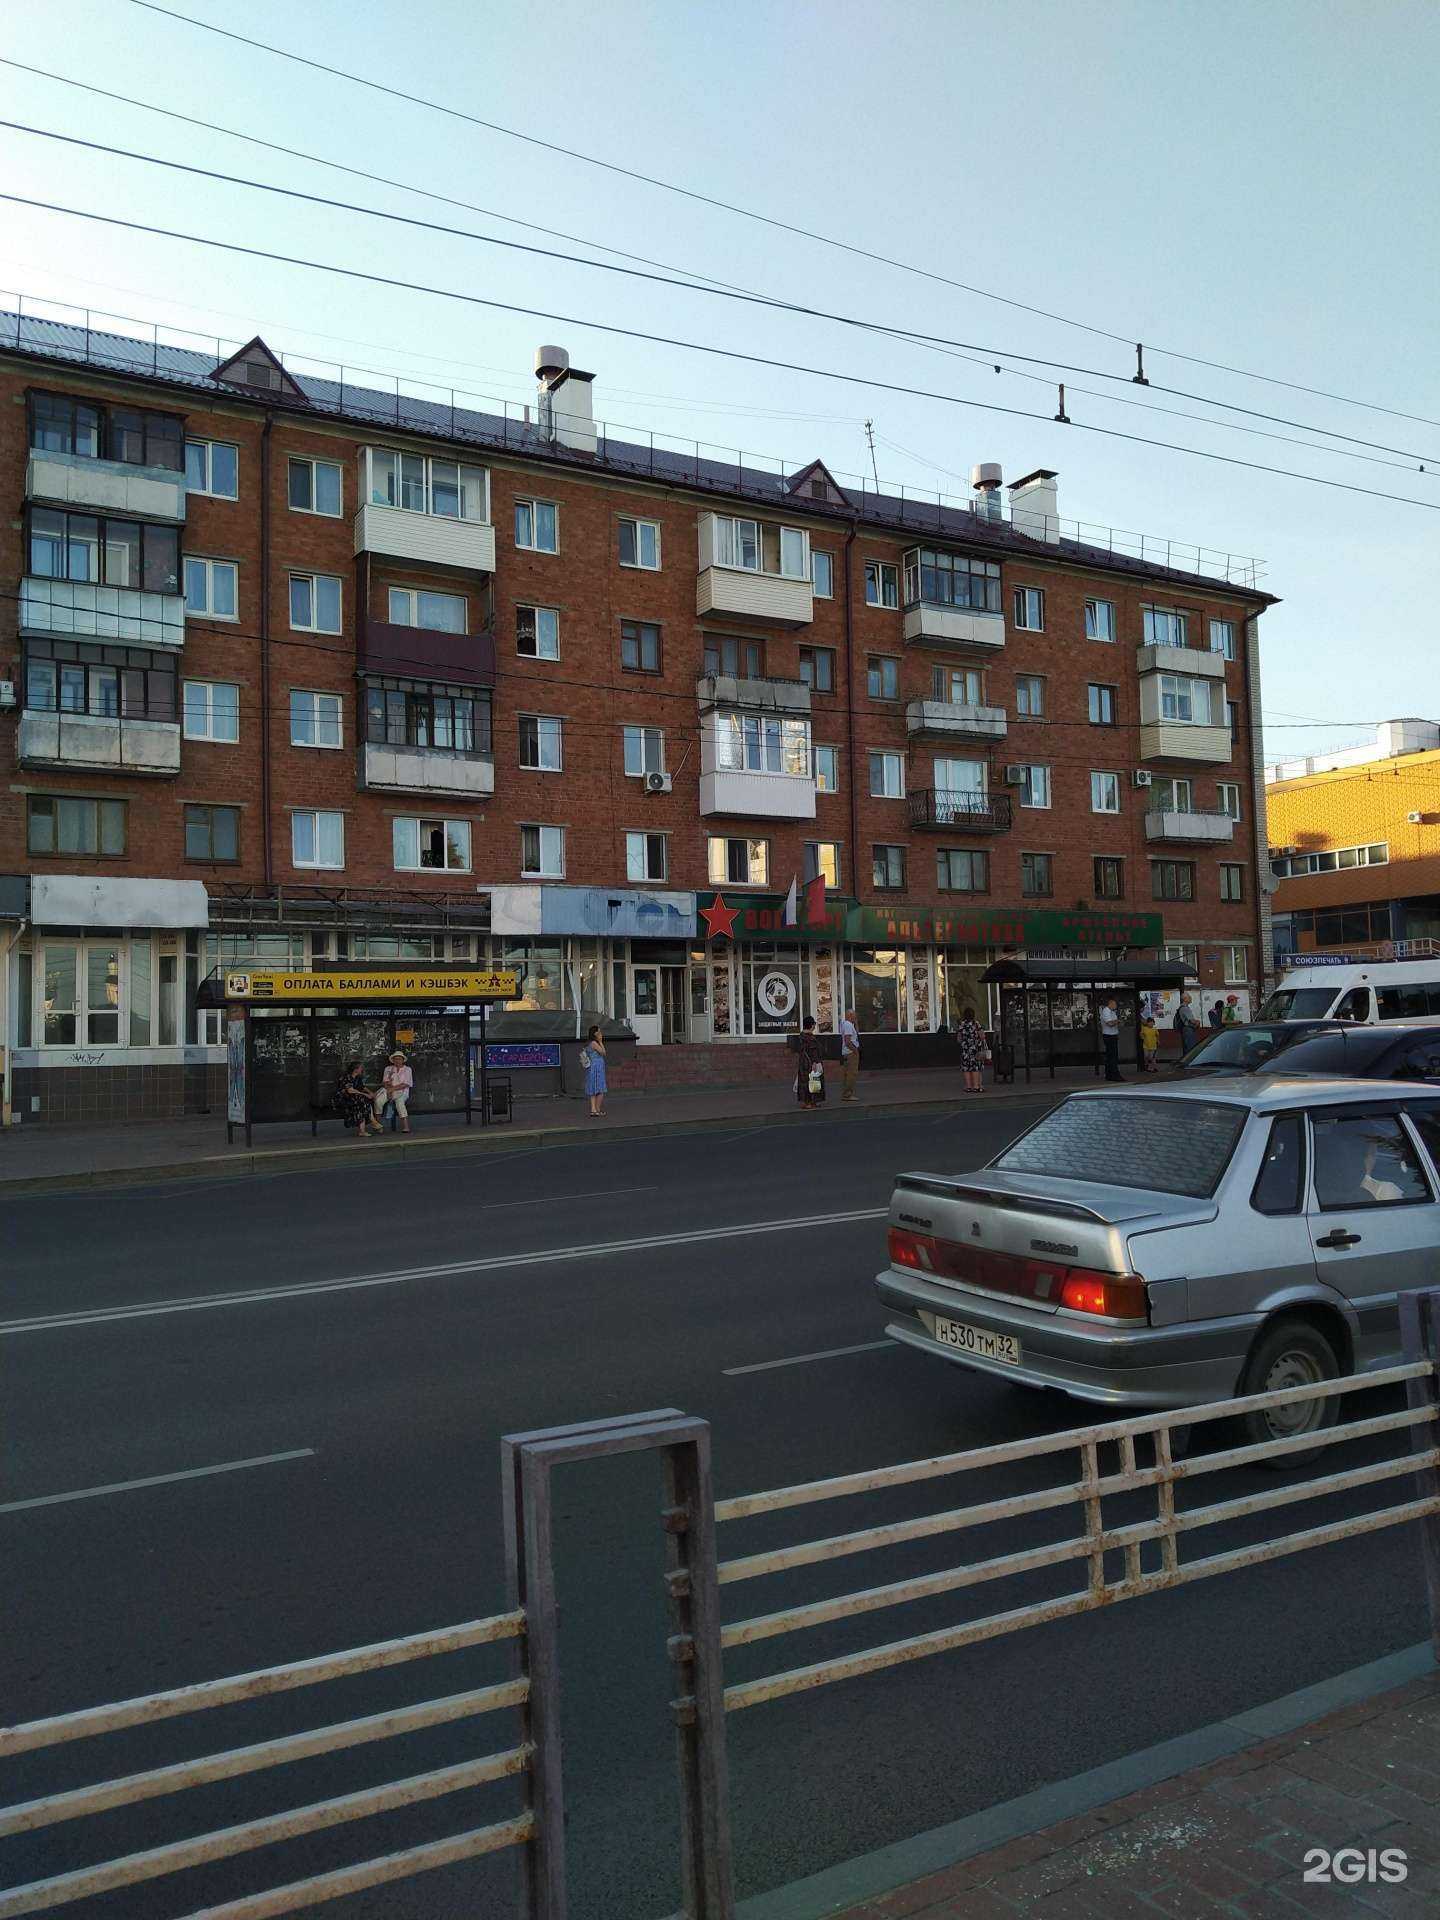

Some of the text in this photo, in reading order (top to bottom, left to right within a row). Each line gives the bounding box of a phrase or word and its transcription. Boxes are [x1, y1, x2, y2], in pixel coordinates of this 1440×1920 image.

[1295, 956, 1342, 965] СОЮЗПЕЧАТЬ
[283, 979, 334, 989] ОПЛАТА
[339, 979, 401, 989] БАЛЛАМИ
[406, 979, 415, 988] И
[420, 978, 468, 989] КЭШБЭК
